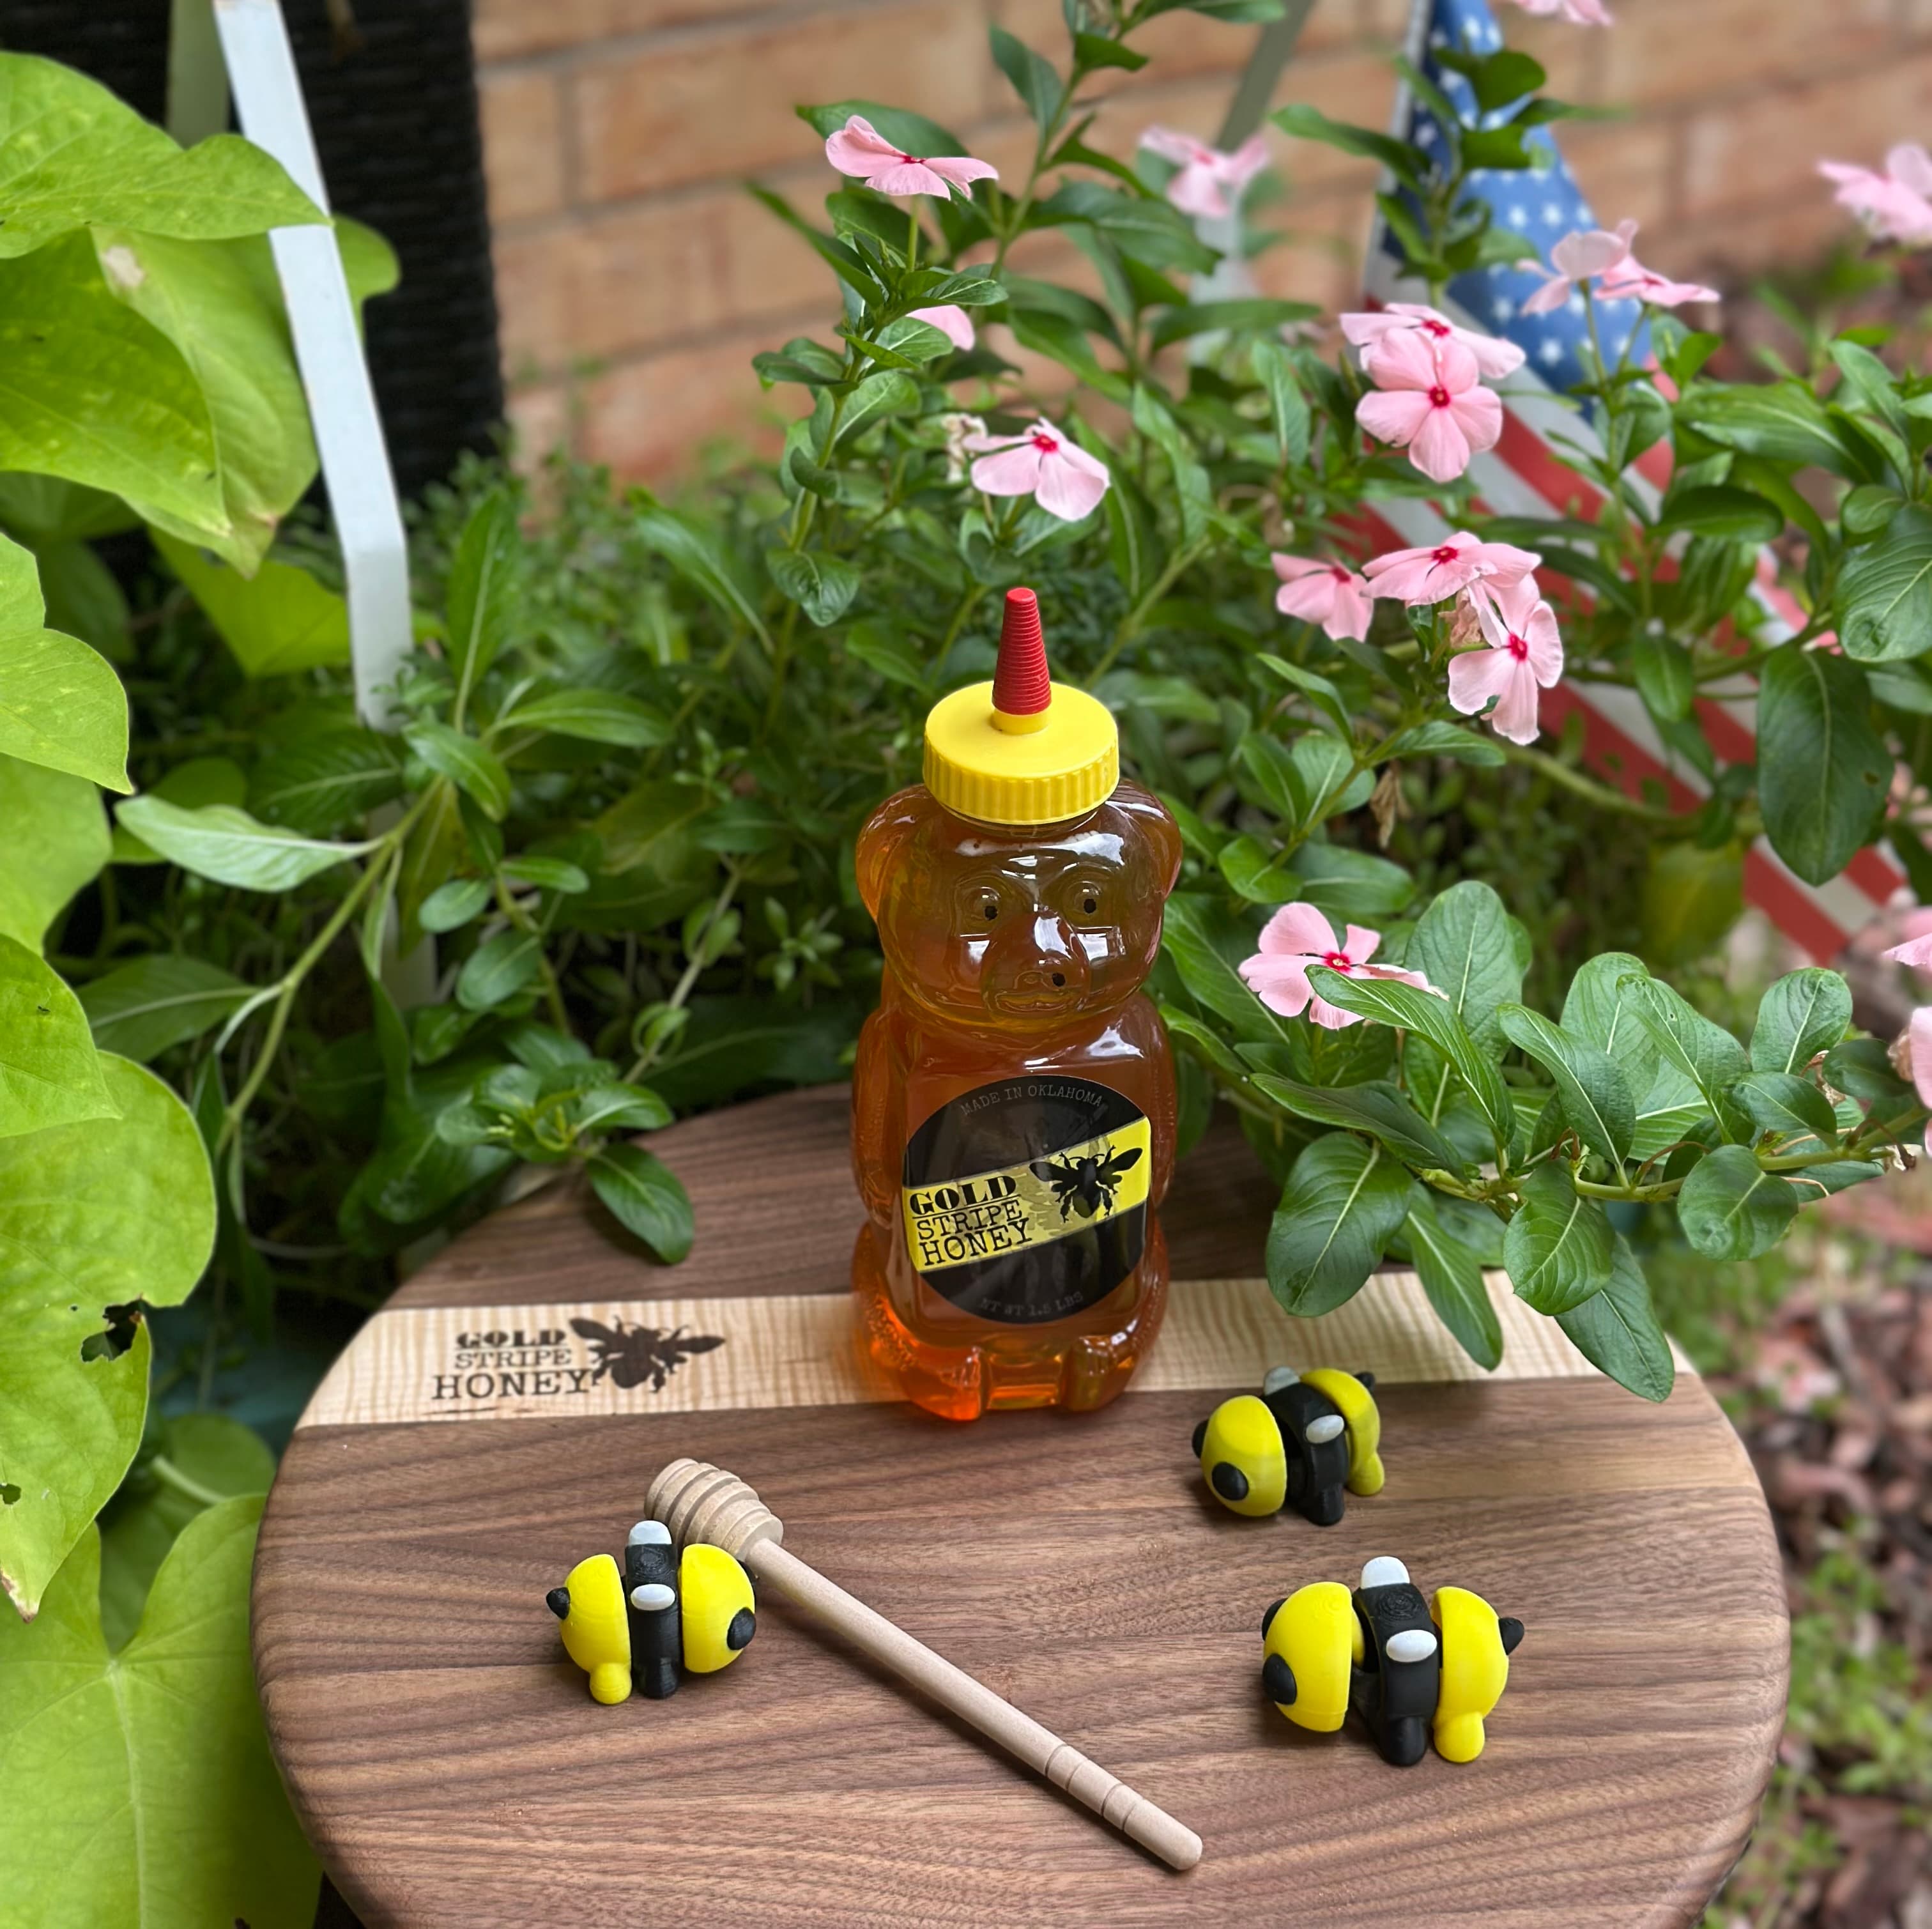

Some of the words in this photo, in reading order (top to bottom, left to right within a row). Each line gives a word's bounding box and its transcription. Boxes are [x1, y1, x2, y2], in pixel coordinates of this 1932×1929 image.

[960, 1091, 1000, 1116] MADE
[1004, 1086, 1022, 1100] IN
[1027, 1084, 1103, 1107] OKLAHOMA
[909, 1175, 1017, 1215] GOLD
[917, 1199, 1022, 1241] STRIPE
[919, 1217, 1032, 1266] HONEY
[456, 1329, 567, 1348] GOLD
[454, 1348, 572, 1370] STRIPE
[432, 1368, 590, 1400] HONEY
